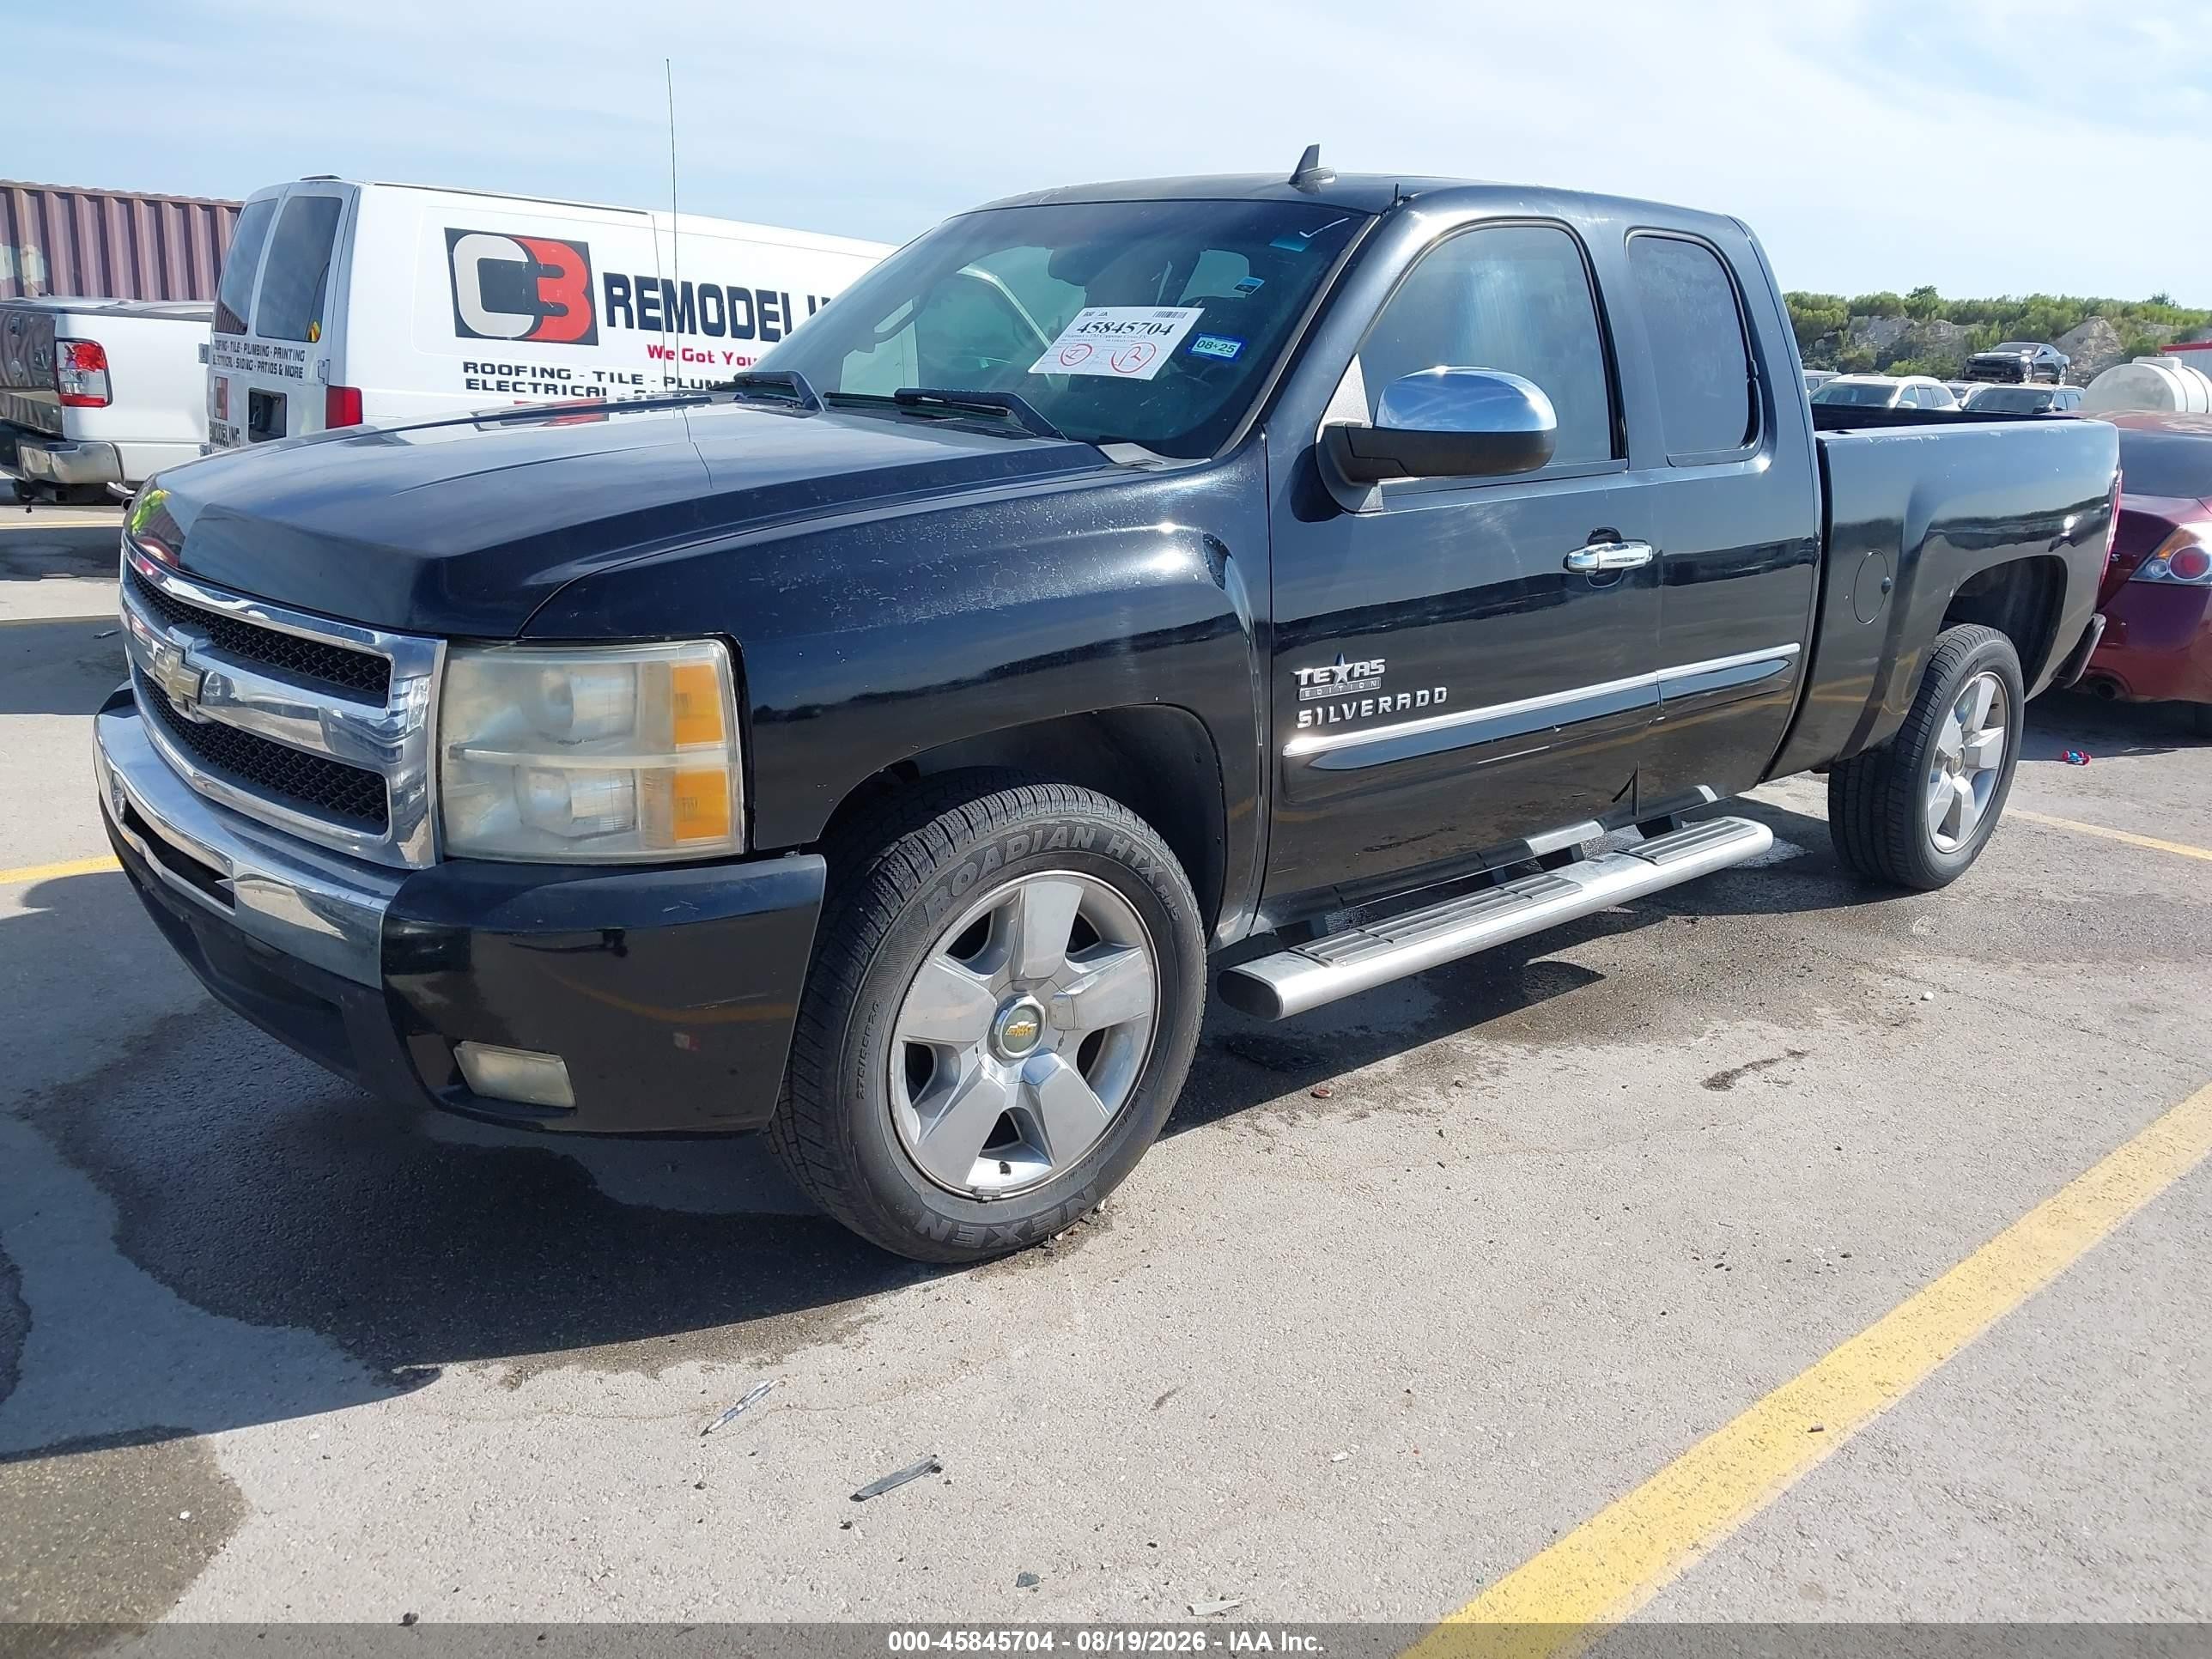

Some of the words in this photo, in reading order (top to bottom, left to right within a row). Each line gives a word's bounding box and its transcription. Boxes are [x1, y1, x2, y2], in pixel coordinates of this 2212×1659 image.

[453, 234, 592, 341] C3
[603, 271, 830, 343] REMODEL
[1076, 321, 1174, 336] 45845704
[273, 346, 306, 362] PRINTING
[647, 343, 675, 361] We
[681, 347, 714, 364] Got
[284, 364, 304, 379] MORE
[462, 361, 572, 380] ROOFING
[592, 370, 643, 386] TILE
[1291, 656, 1387, 687] TEXAS
[1304, 679, 1377, 698] EDITION
[1297, 686, 1448, 729] SILVERADO
[925, 825, 1097, 927] ROADIAN
[1104, 834, 1167, 884] HTX
[915, 1182, 1097, 1249] NEXEN
